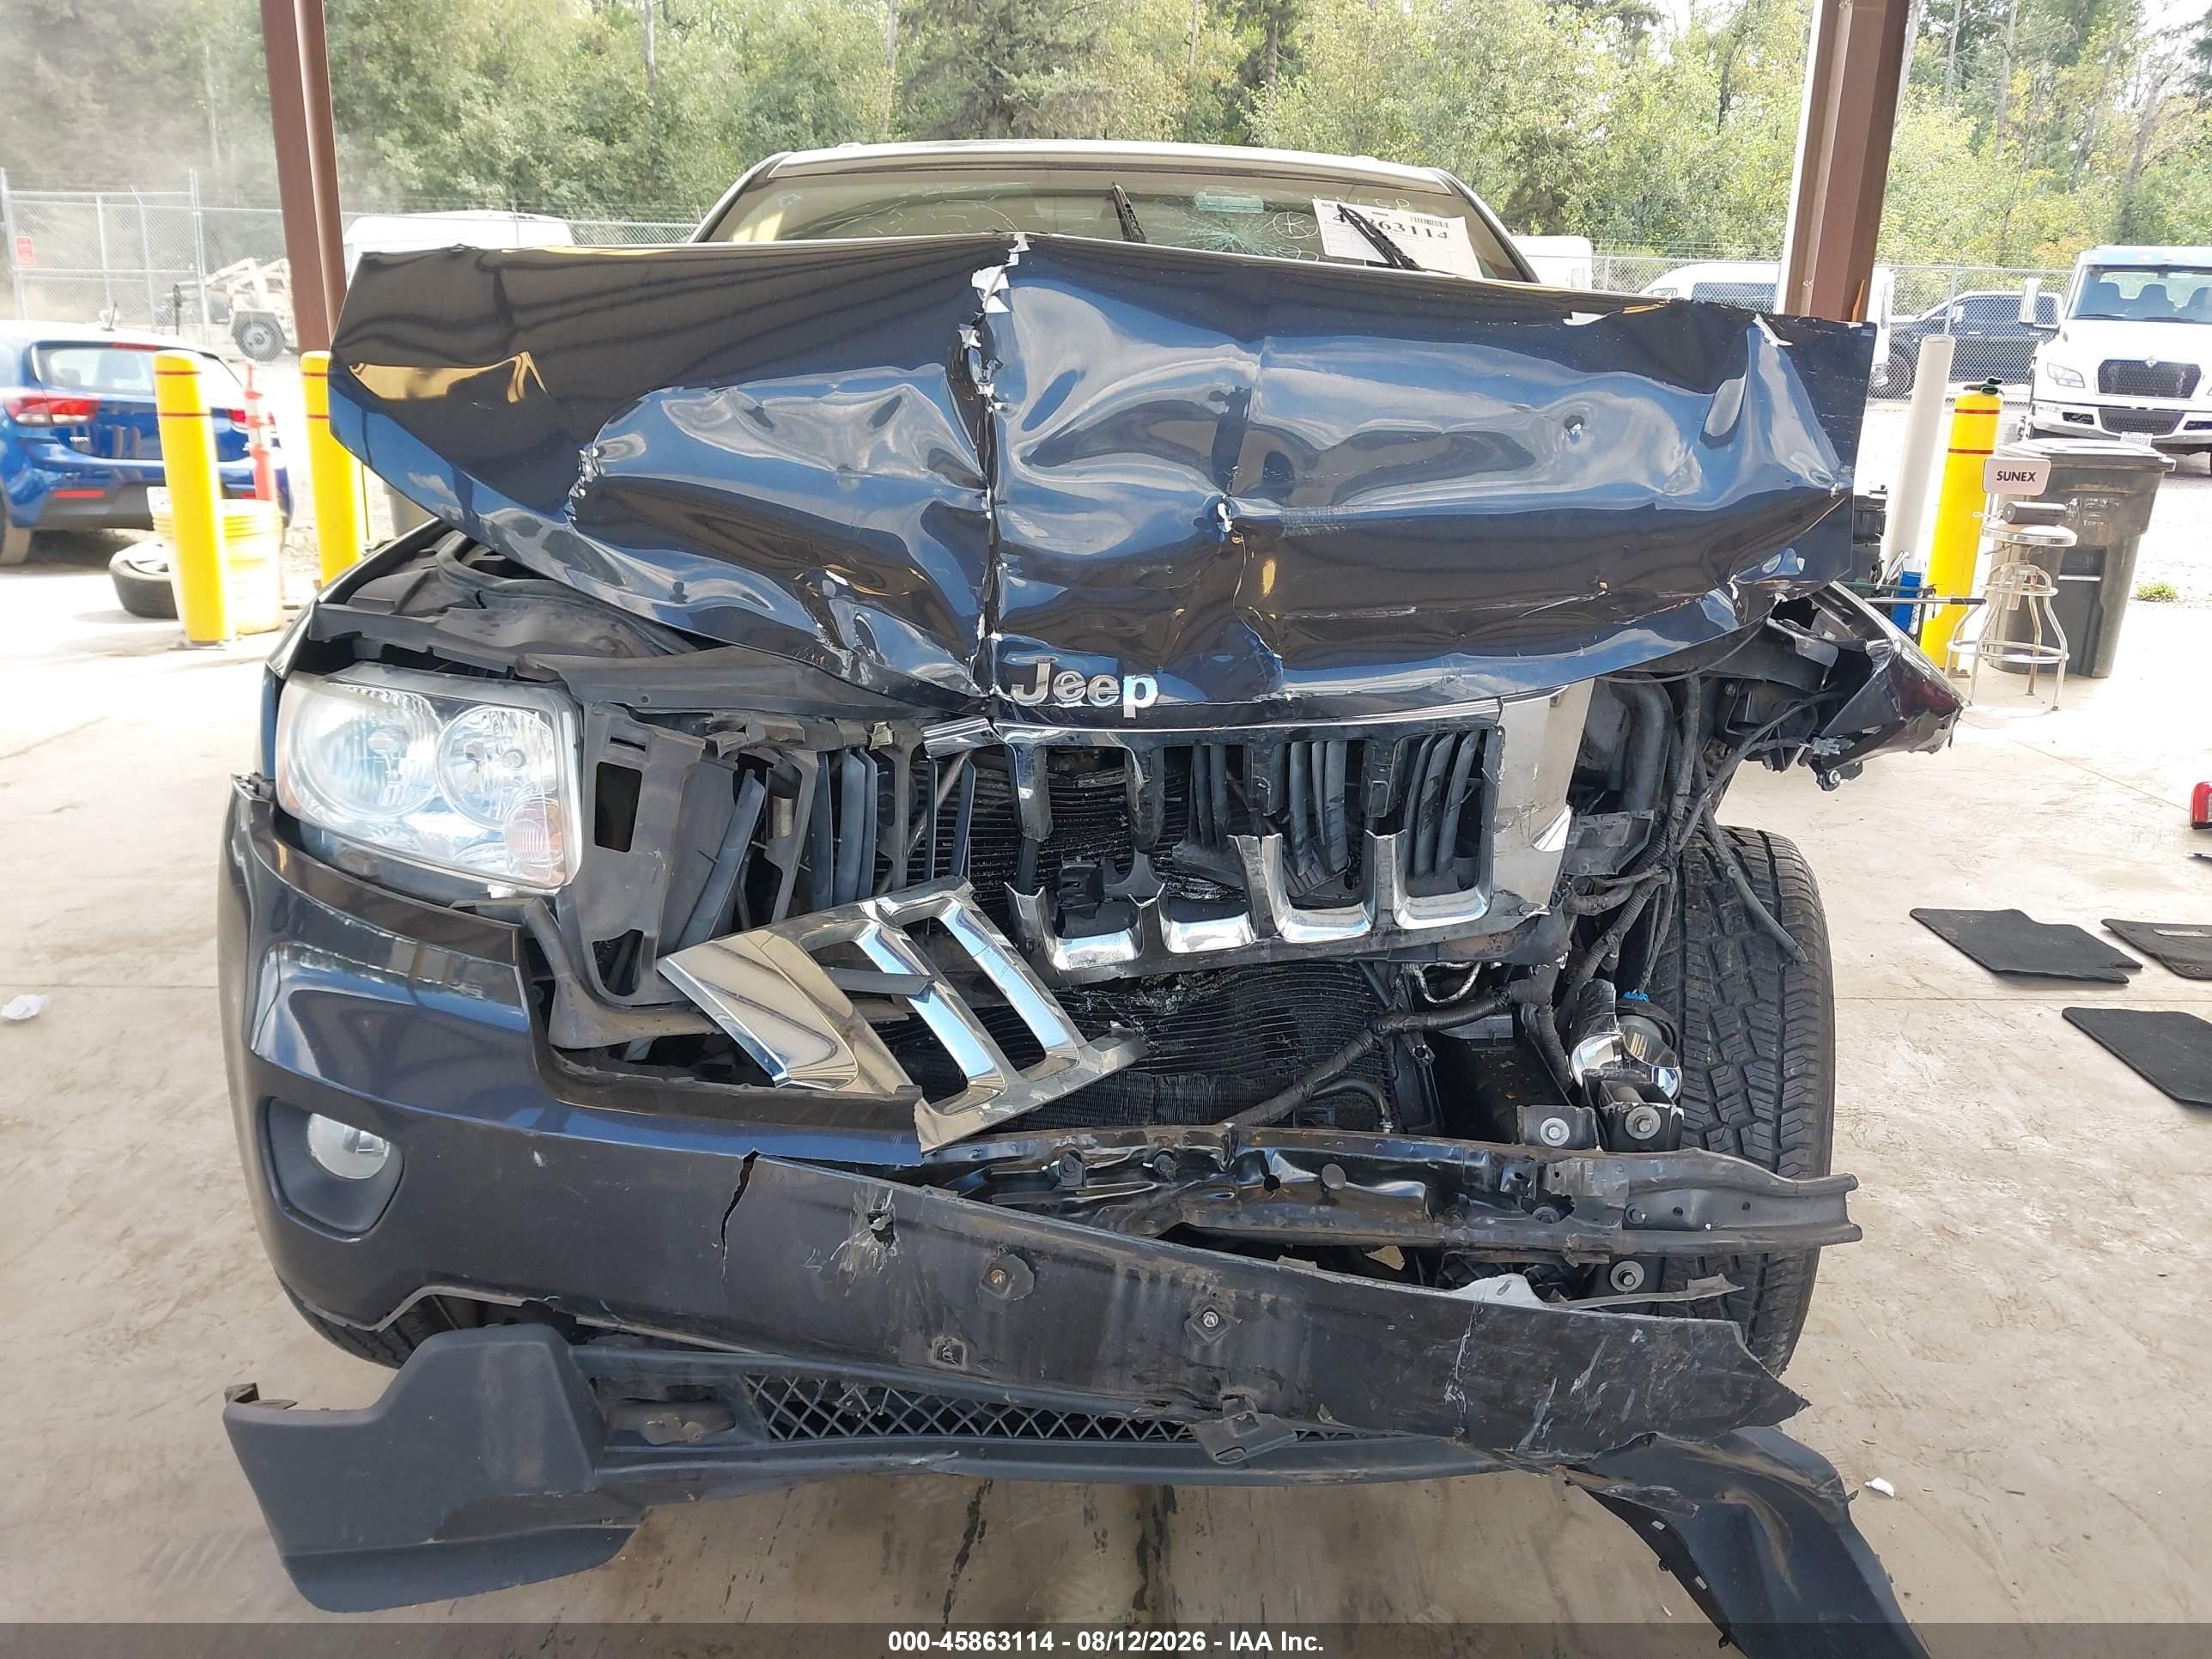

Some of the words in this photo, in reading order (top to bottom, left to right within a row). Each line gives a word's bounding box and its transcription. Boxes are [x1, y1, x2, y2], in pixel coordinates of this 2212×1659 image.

[1333, 213, 1449, 239] 463114
[1996, 471, 2037, 482] SUNEX
[1011, 657, 1158, 719] Jeep
